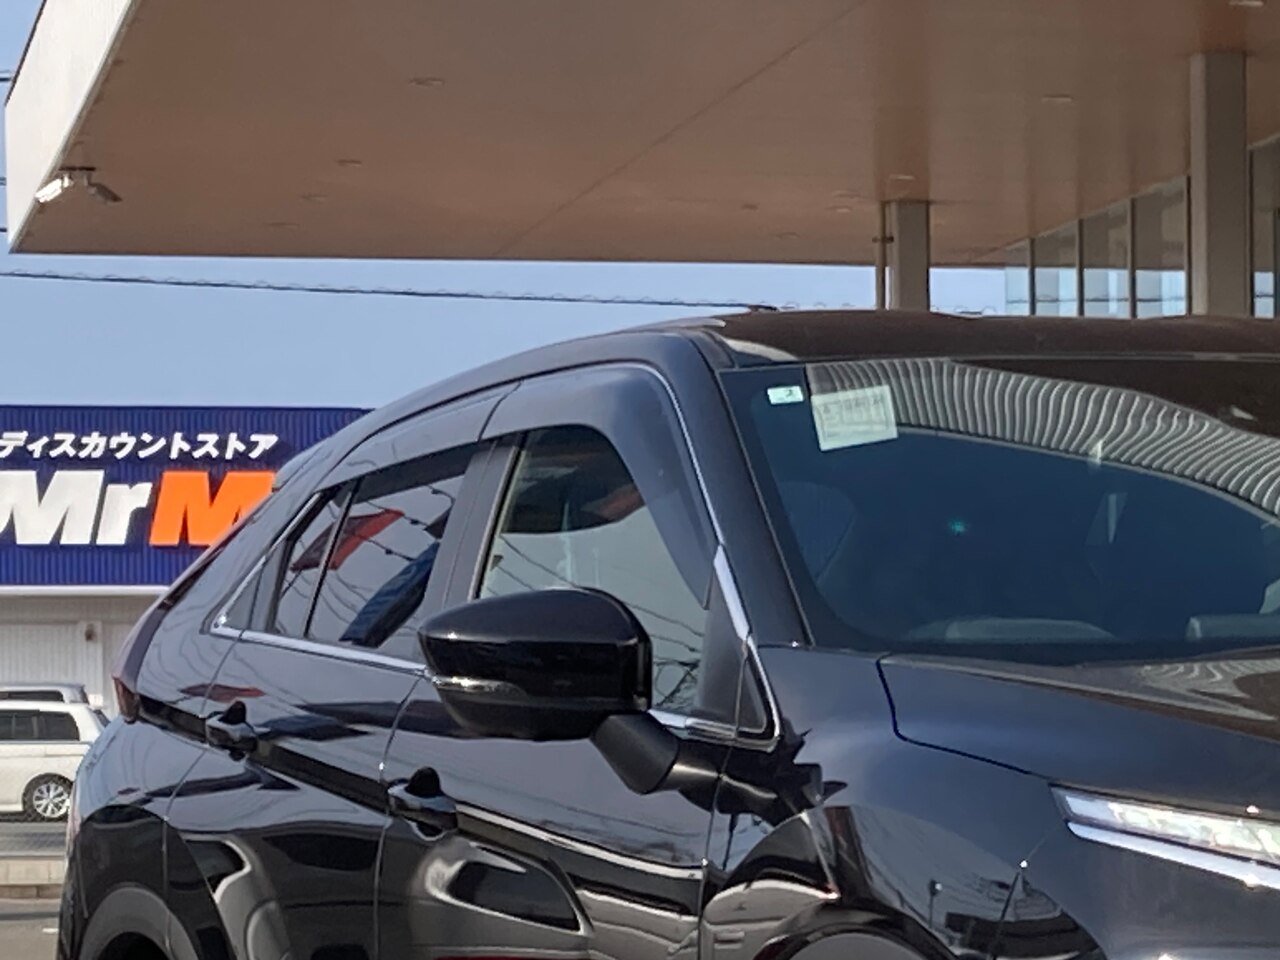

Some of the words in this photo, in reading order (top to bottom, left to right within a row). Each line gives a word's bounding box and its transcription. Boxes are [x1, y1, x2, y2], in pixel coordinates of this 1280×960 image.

[0, 430, 279, 460] ディスカウントストア
[0, 469, 276, 546] MrM
